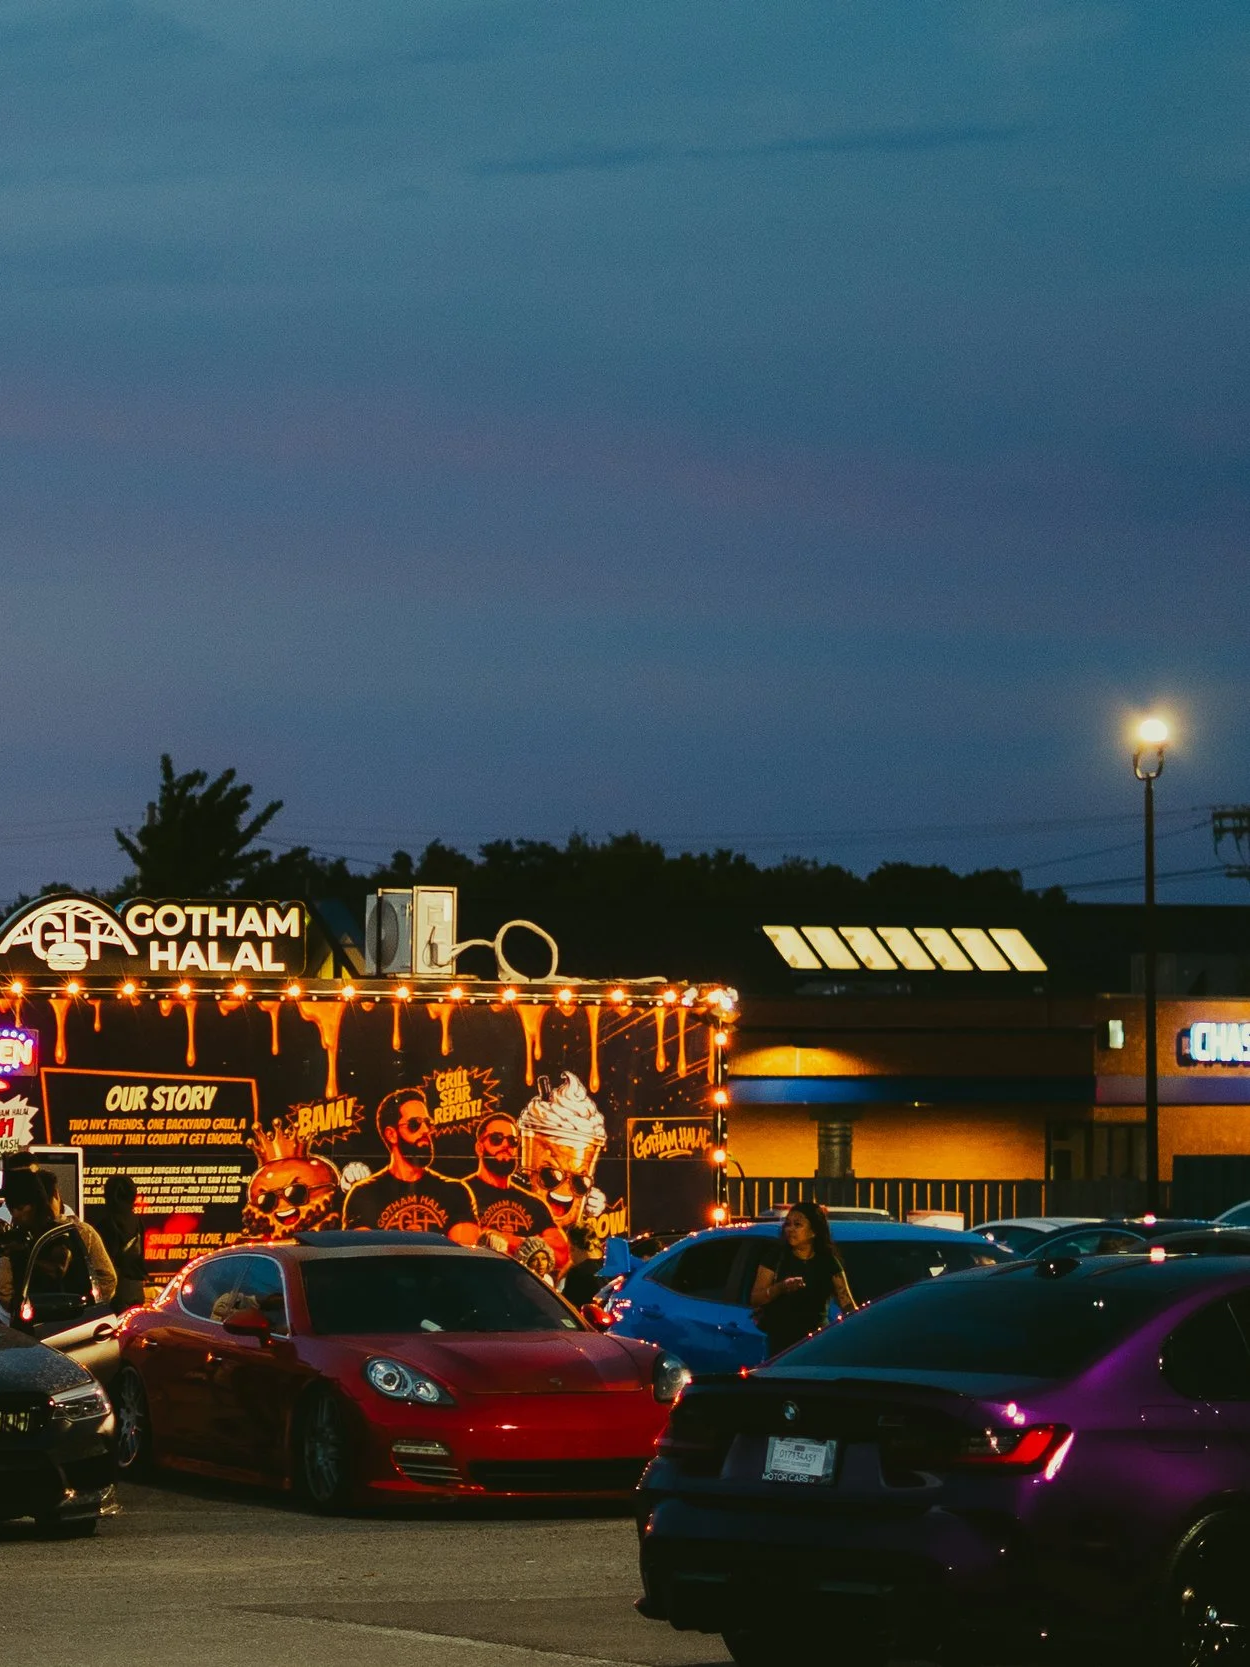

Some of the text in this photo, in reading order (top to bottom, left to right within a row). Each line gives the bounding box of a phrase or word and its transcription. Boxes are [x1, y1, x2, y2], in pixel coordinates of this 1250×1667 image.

[125, 904, 300, 938] GOTHAM
[150, 941, 285, 972] HALAL
[436, 1068, 470, 1092] GRILL
[105, 1085, 219, 1112] OUR STORY
[439, 1086, 472, 1107] SEAR
[298, 1097, 356, 1137] BAM!
[433, 1098, 483, 1125] REPEAT!
[377, 1195, 449, 1228] GOTHAM HALAL
[762, 1472, 788, 1482] MOTOR
